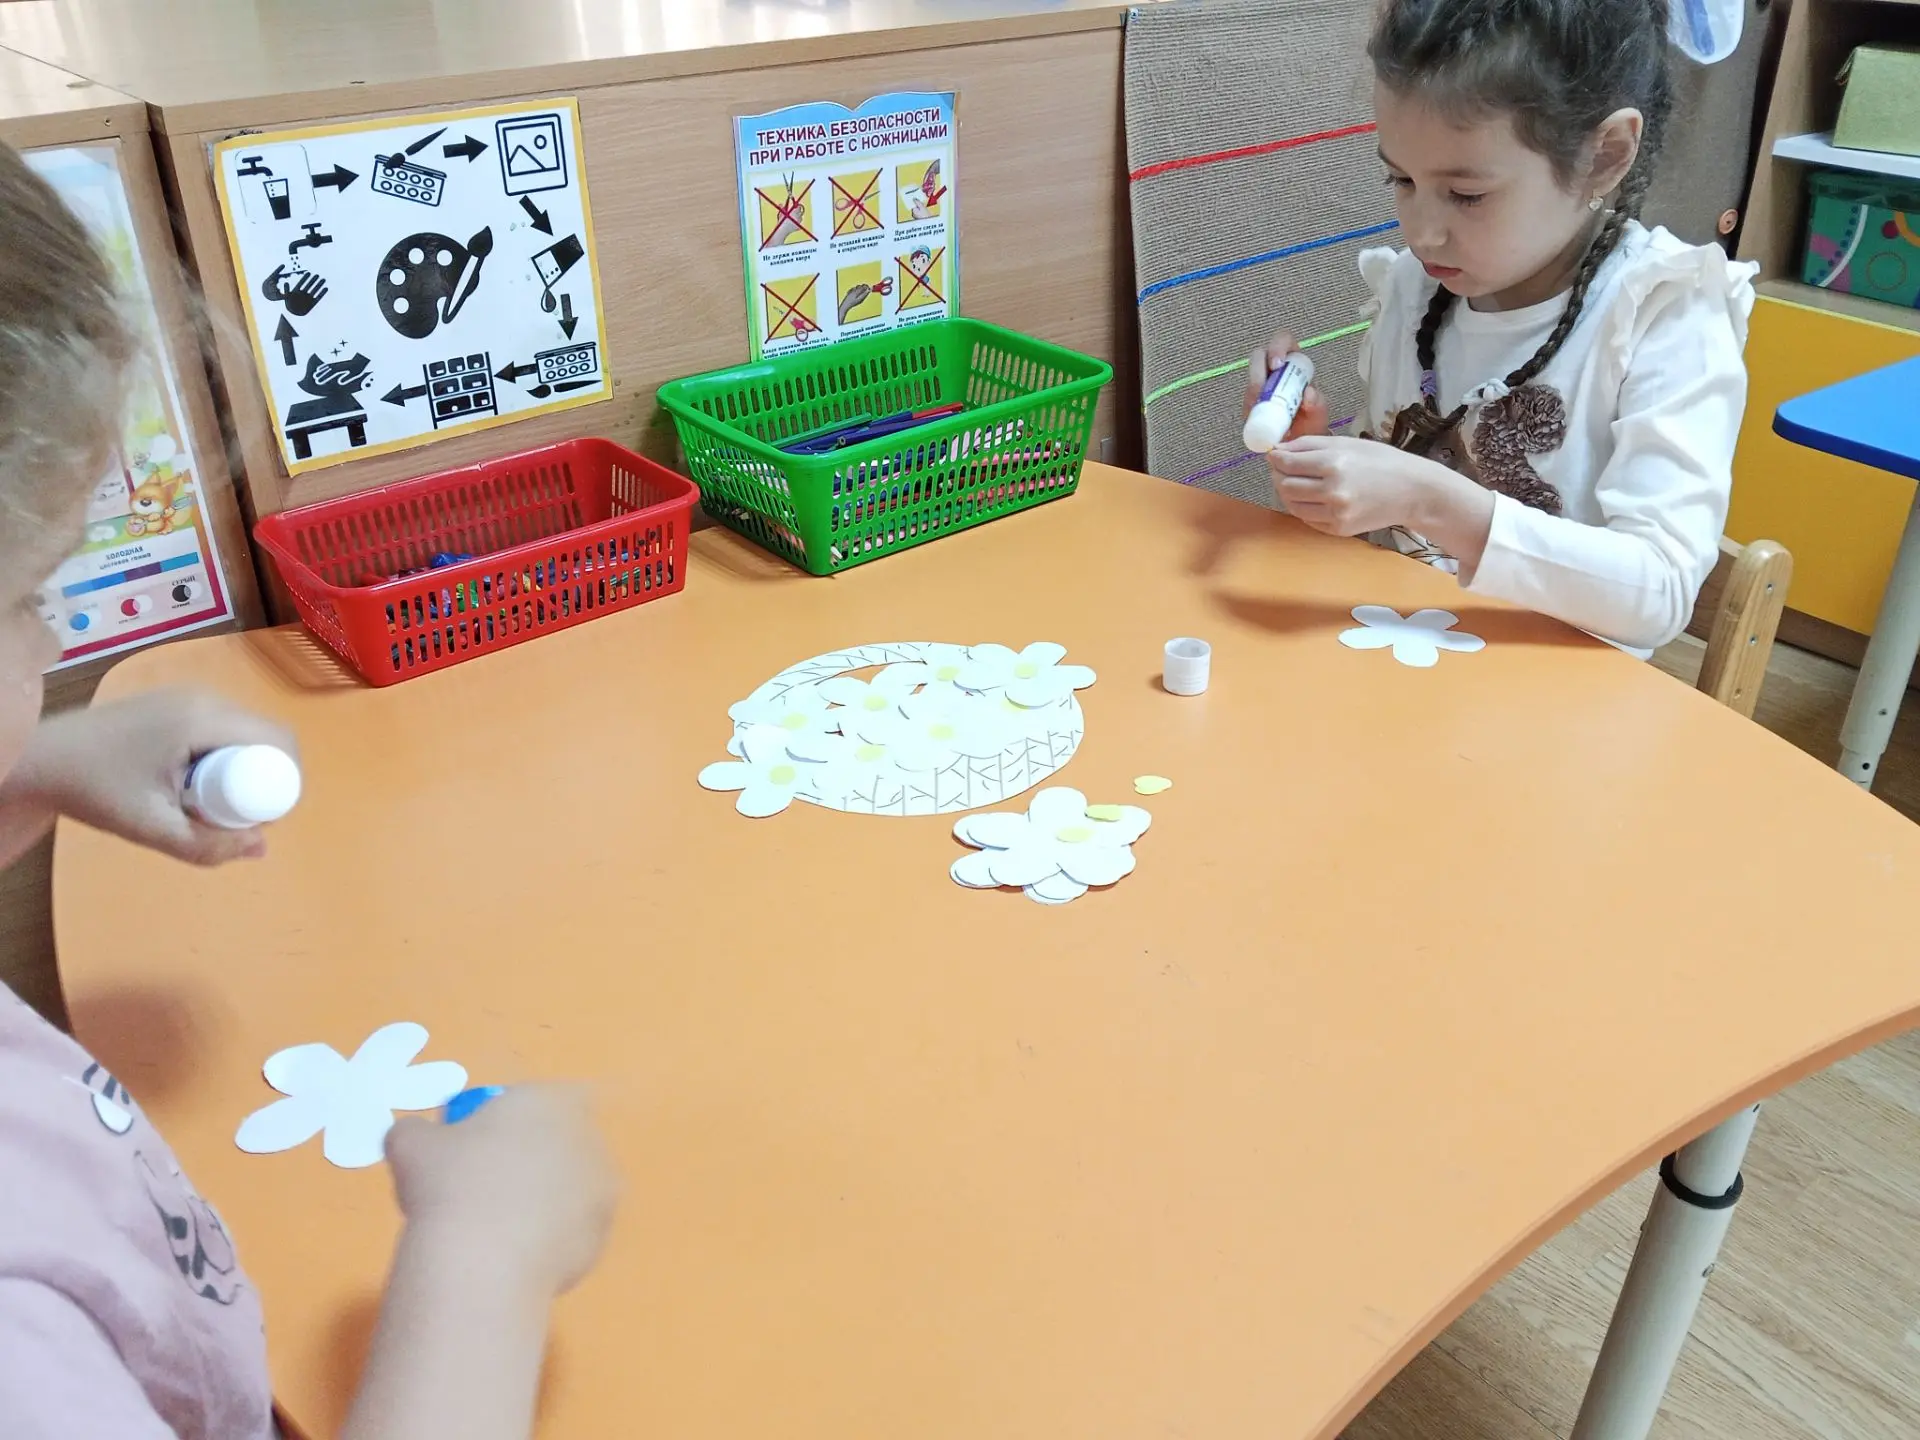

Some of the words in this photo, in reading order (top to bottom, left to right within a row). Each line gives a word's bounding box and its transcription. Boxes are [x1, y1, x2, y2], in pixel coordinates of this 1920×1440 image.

[750, 149, 780, 166] ПРИ
[785, 140, 844, 160] РАБОТЕ
[849, 138, 857, 151] С
[862, 124, 947, 150] НОЖНИЦАМИ
[757, 126, 826, 147] ТЕХНИКА
[831, 108, 940, 136] БЕЗОПАСНОСТИ
[106, 546, 144, 560] ХОЛОДНАЯ
